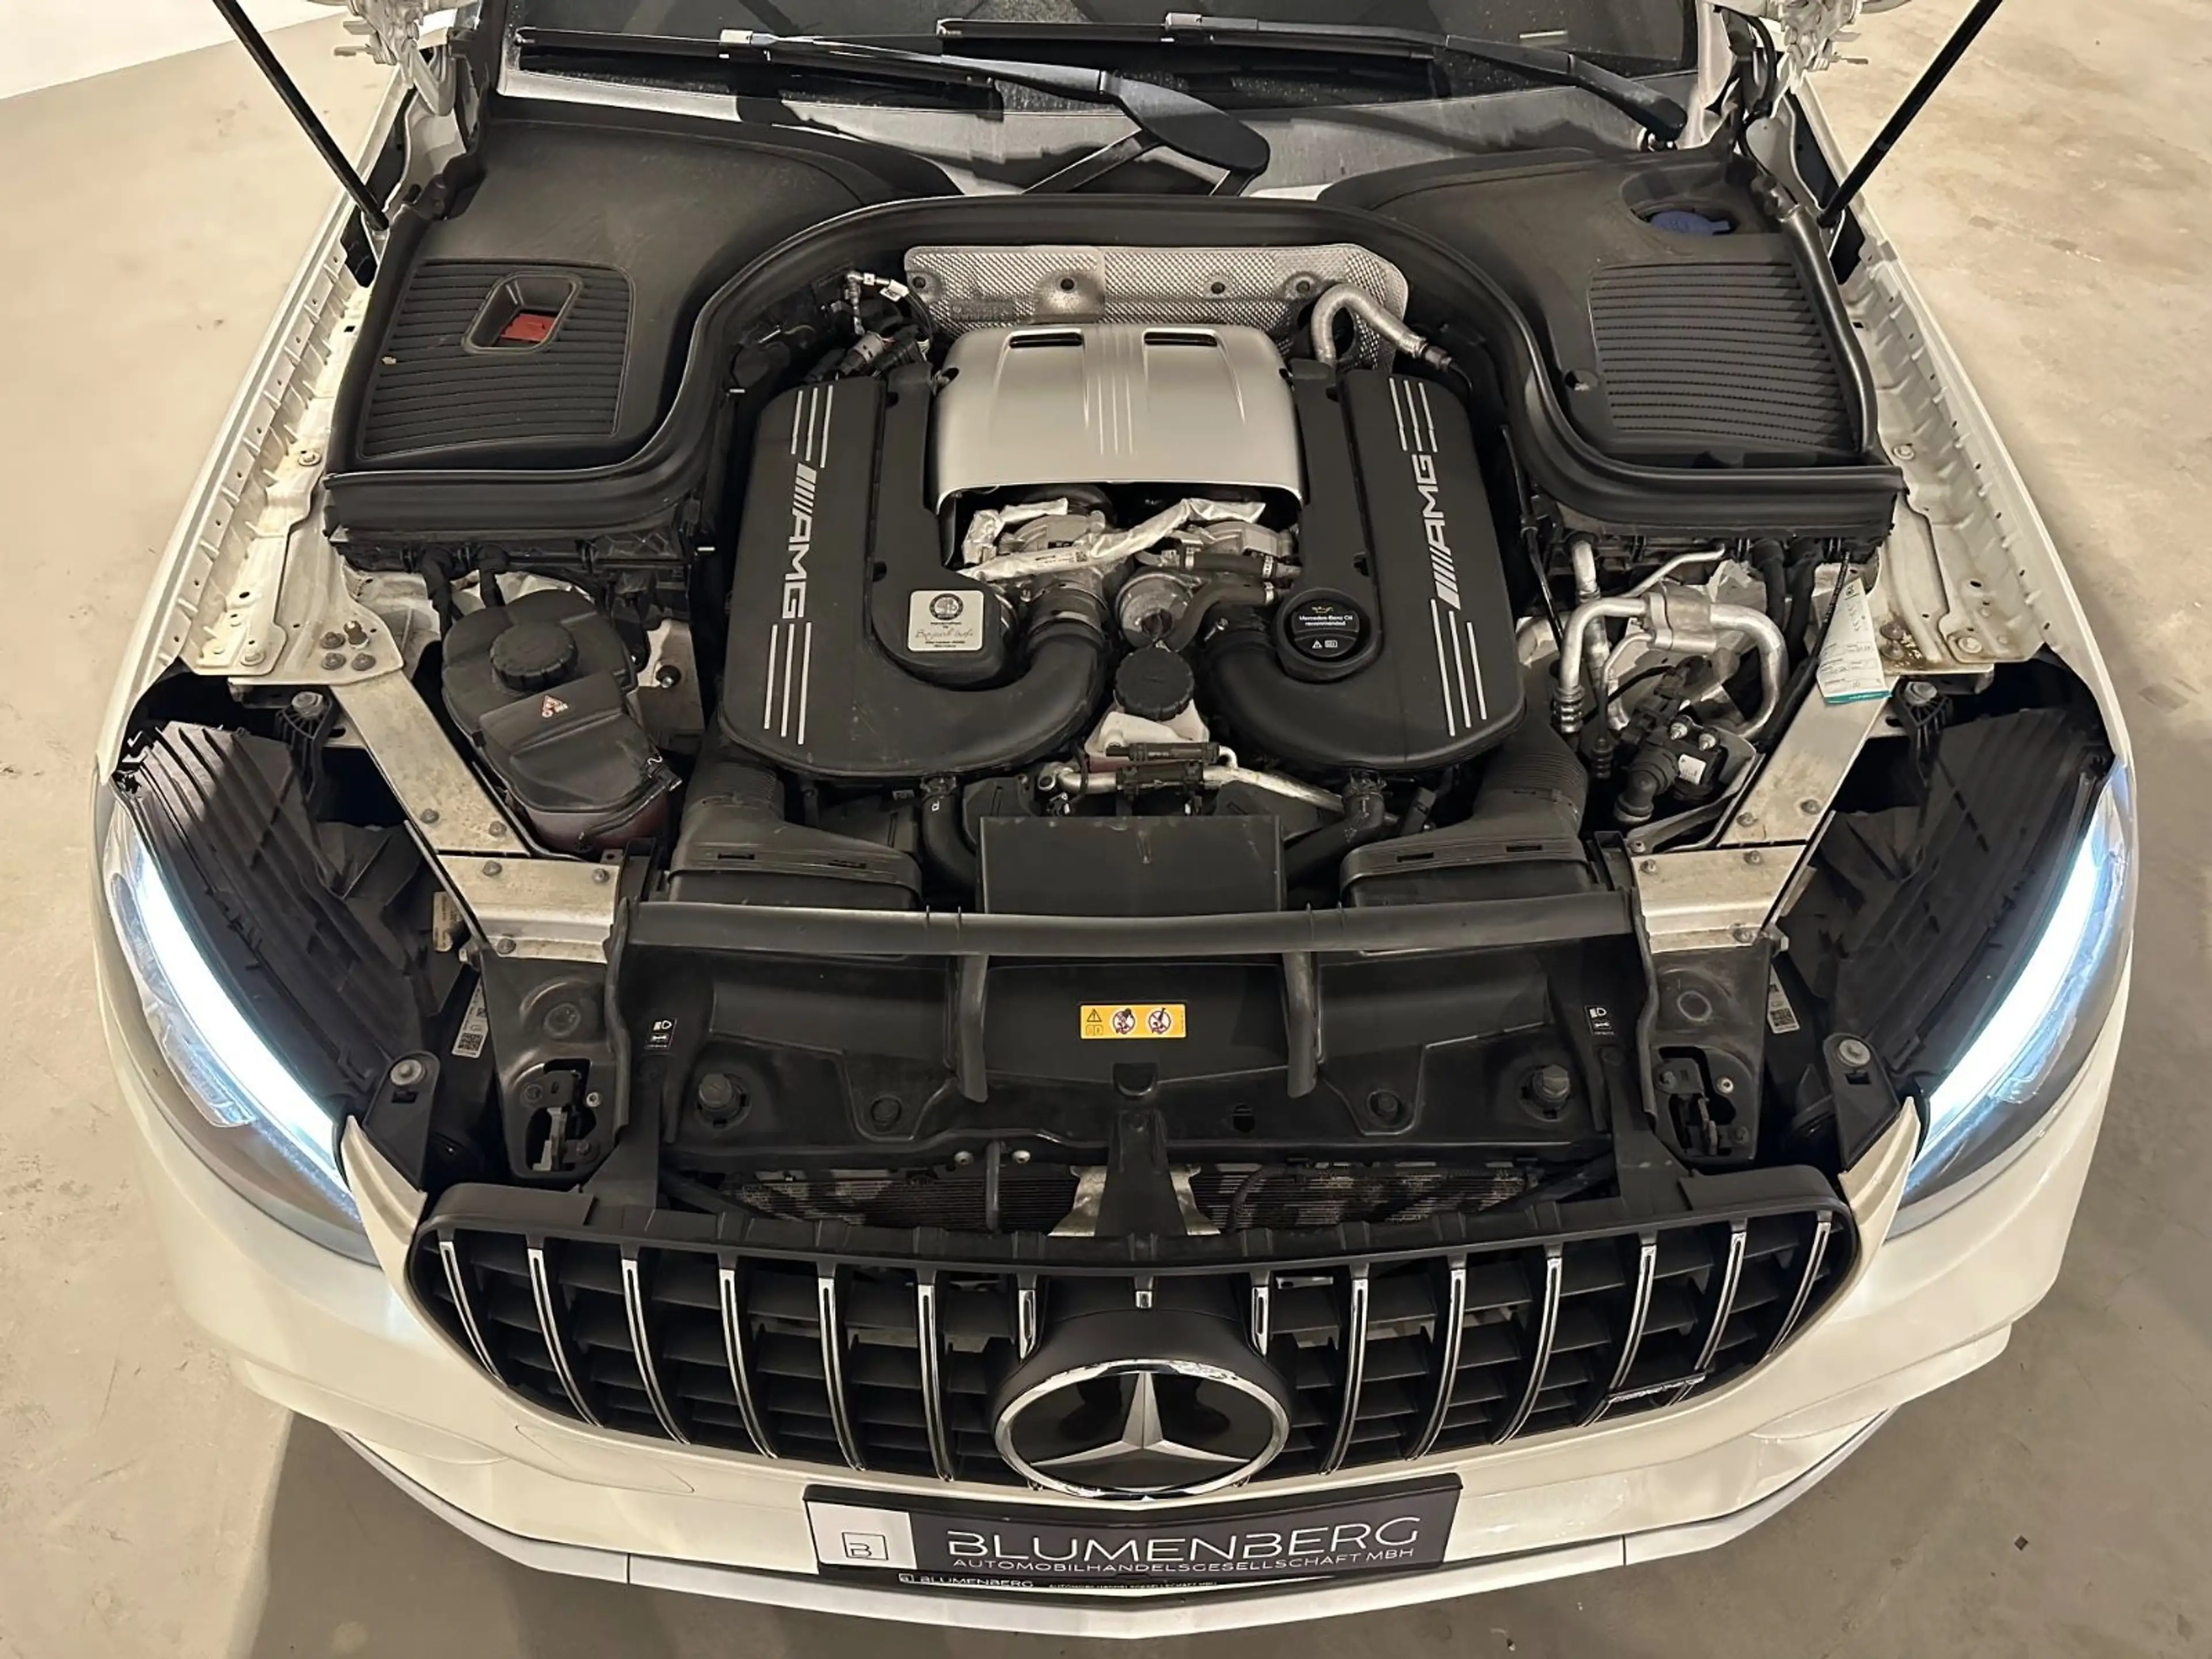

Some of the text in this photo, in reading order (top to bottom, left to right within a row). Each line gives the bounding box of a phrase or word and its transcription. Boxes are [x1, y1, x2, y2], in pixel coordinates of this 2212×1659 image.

[1411, 453, 1452, 556] AMG
[782, 507, 813, 619] AMG
[946, 1516, 1421, 1562] BLUMENBERG
[953, 1548, 1414, 1572] AUTOMOBILHANDELSGESELLSCHAFT MBH
